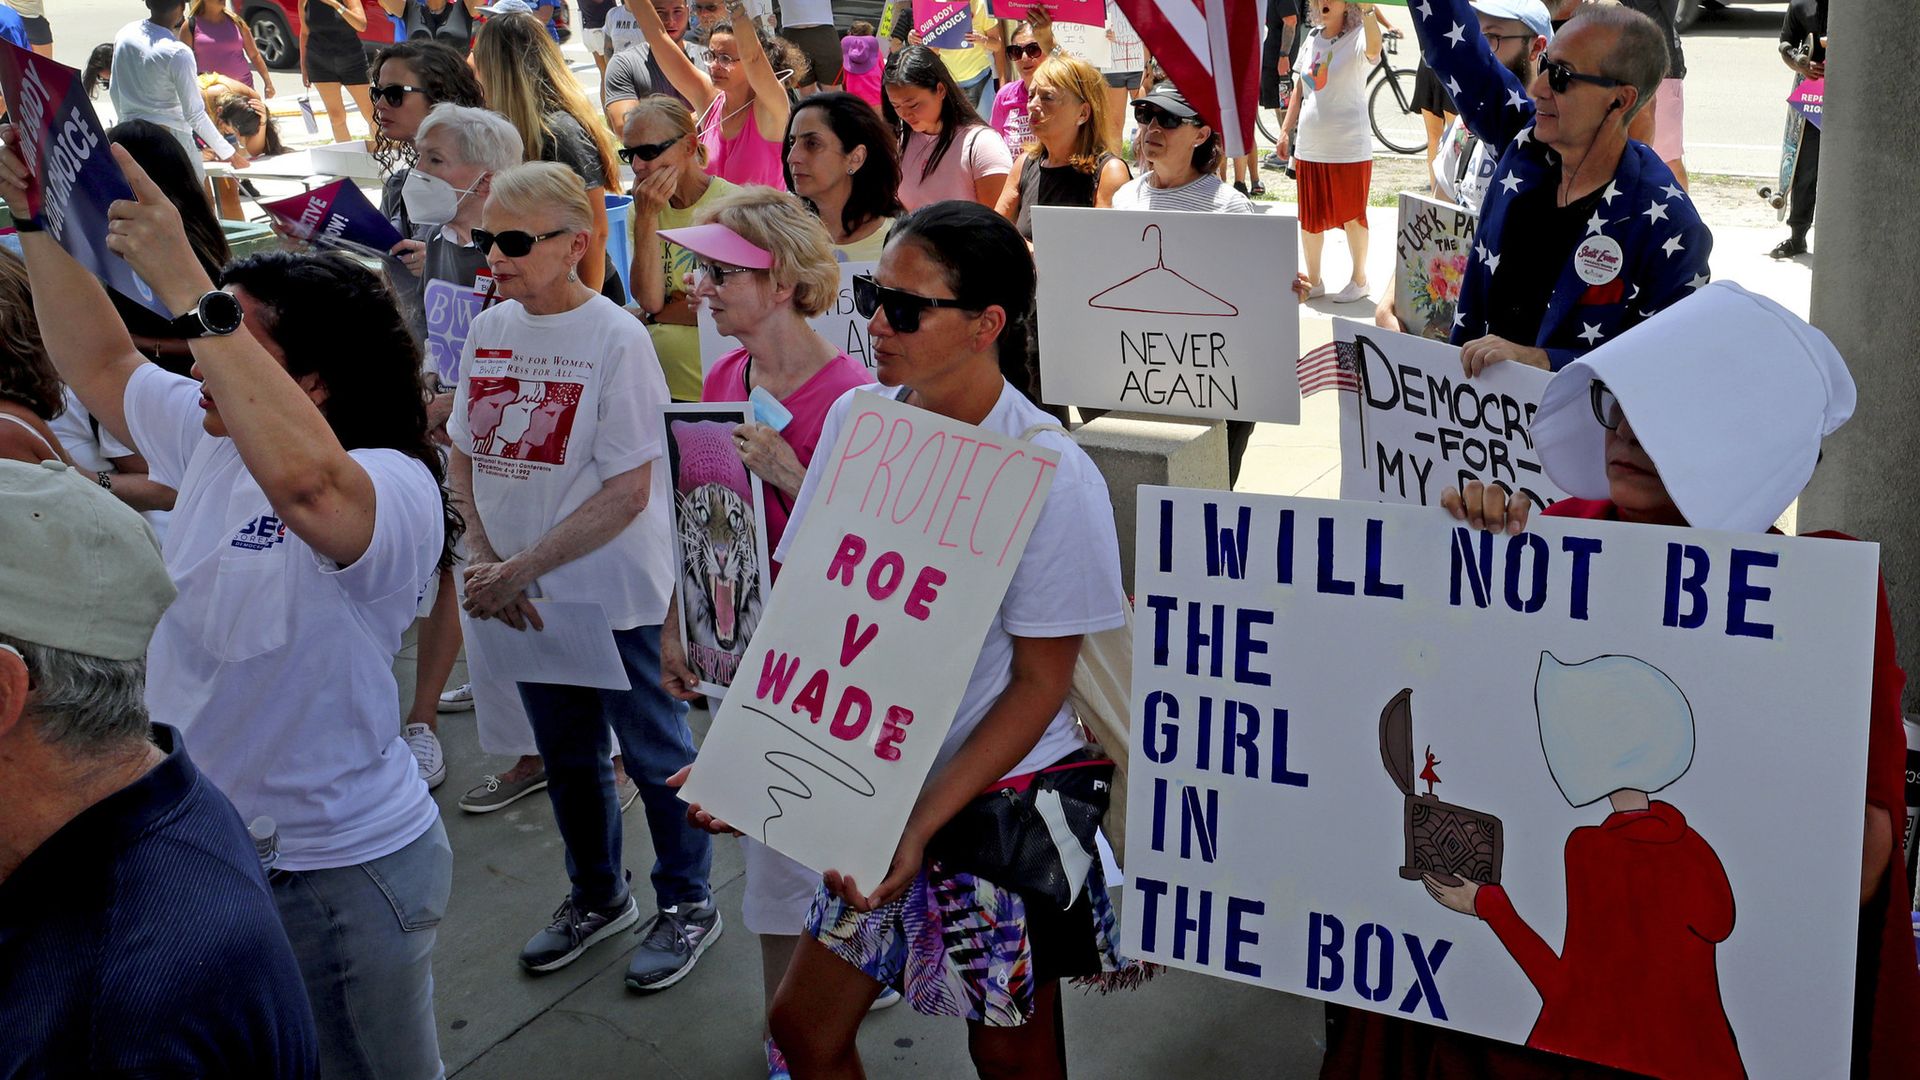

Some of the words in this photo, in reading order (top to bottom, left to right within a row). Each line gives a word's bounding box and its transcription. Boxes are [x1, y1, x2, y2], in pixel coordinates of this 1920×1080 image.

[616, 20, 631, 30] WAR
[920, 19, 934, 32] OUR
[933, 4, 953, 23] BODY
[922, 32, 936, 45] OUR
[935, 11, 967, 35] CHOICE
[17, 58, 50, 143] BODY
[47, 105, 98, 201] CHOICE
[45, 186, 66, 241] OUR
[1454, 210, 1480, 240] PA
[1434, 239, 1458, 252] THE
[528, 357, 547, 365] FOR
[533, 368, 550, 376] FOR
[1120, 330, 1229, 368] NEVER
[1120, 369, 1238, 410] AGAIN
[826, 411, 1057, 567] PROTECT
[1377, 441, 1433, 506] MY
[826, 533, 947, 621] ROE
[1159, 500, 1173, 573] I
[1204, 502, 1404, 600] WILL
[1450, 527, 1602, 620] NOT
[1662, 542, 1779, 640] BE
[839, 613, 879, 668] V
[1147, 594, 1274, 686] THE
[755, 649, 914, 762] WADE
[1143, 690, 1309, 788] GIRL
[1151, 778, 1219, 863] IN
[1135, 877, 1265, 978] THE
[1306, 911, 1453, 1021] BOX
